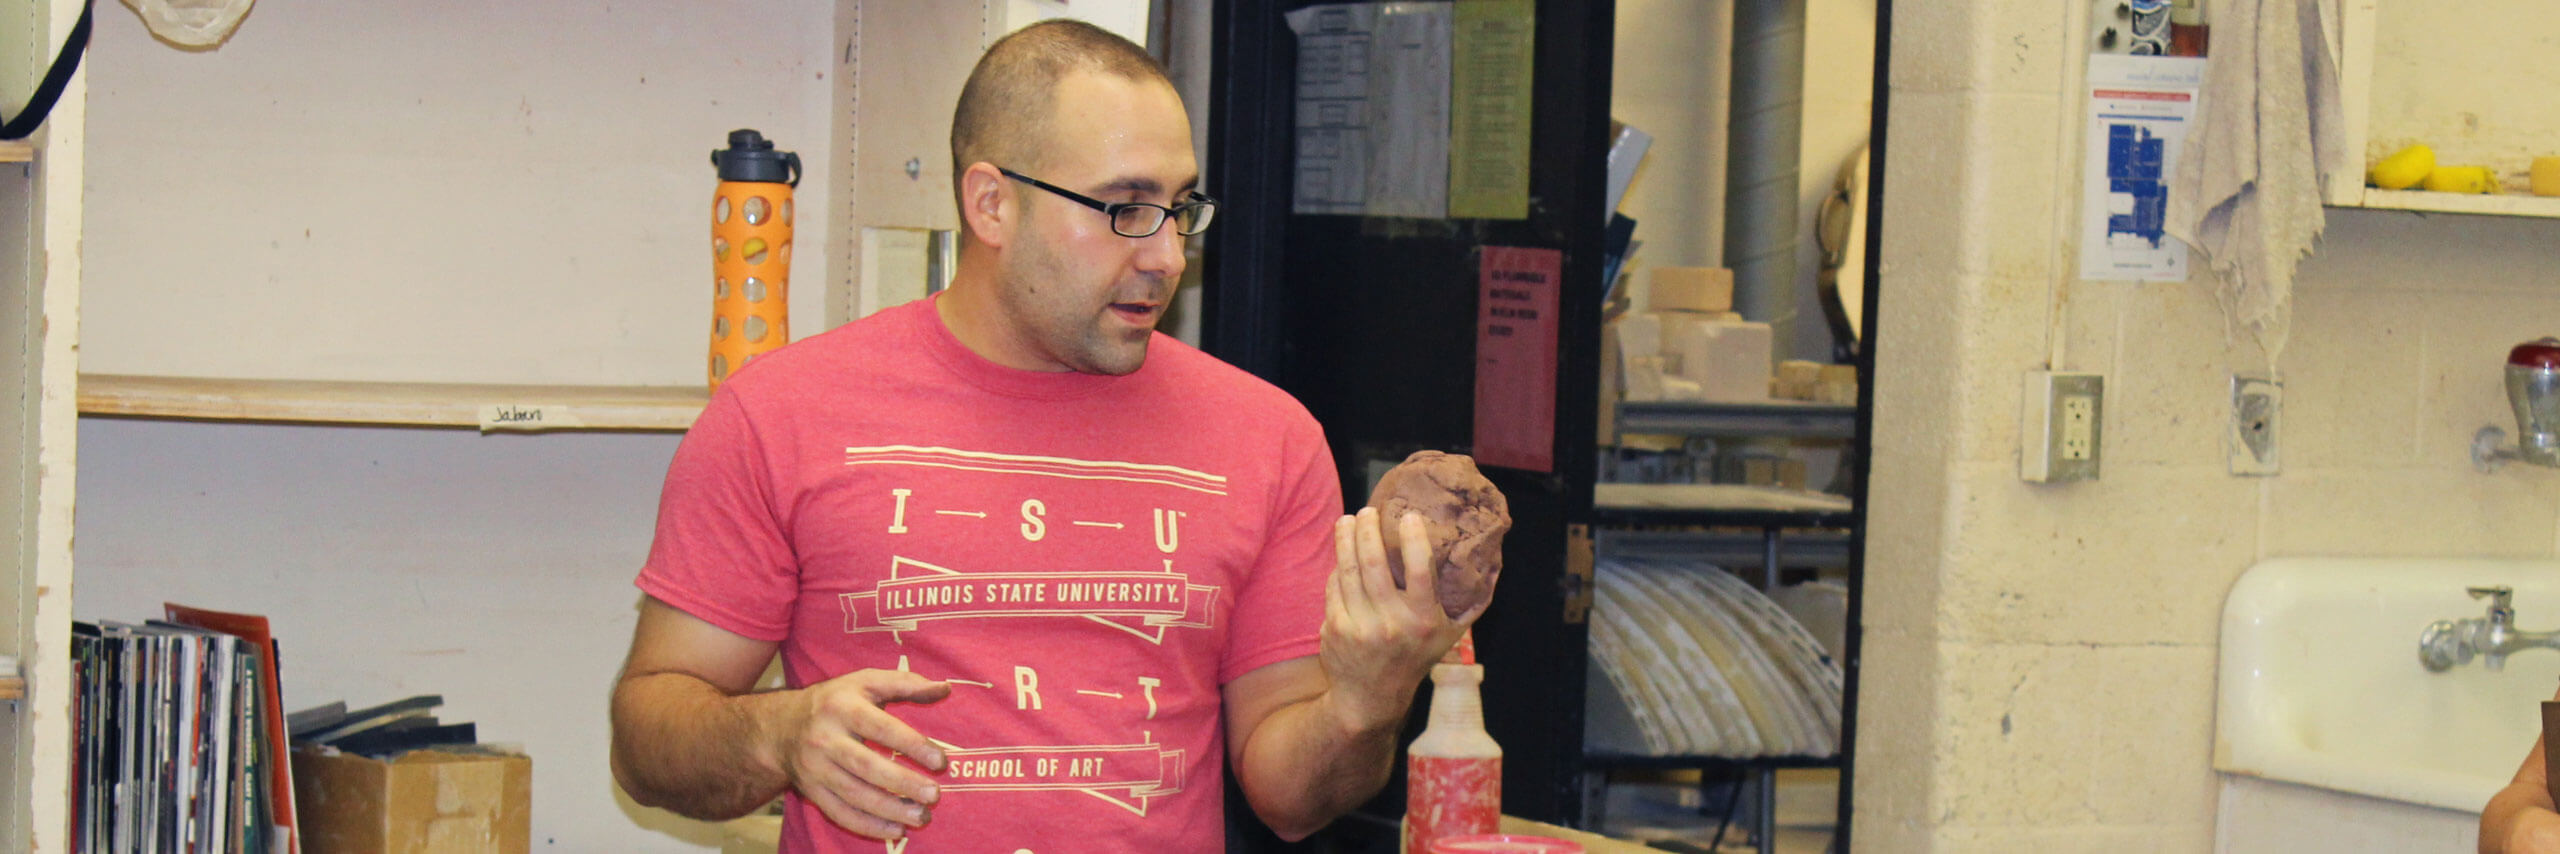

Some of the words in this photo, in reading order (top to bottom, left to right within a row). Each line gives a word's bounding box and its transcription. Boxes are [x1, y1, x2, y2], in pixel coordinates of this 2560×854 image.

[887, 488, 912, 534] I
[1020, 499, 1046, 542] S
[886, 583, 974, 610] ILLINOIS
[986, 583, 1046, 602] STATE
[1014, 666, 1042, 710] R
[949, 759, 1025, 778] SCHOOL
[1036, 758, 1059, 777] OF
[1069, 757, 1105, 777] ART
